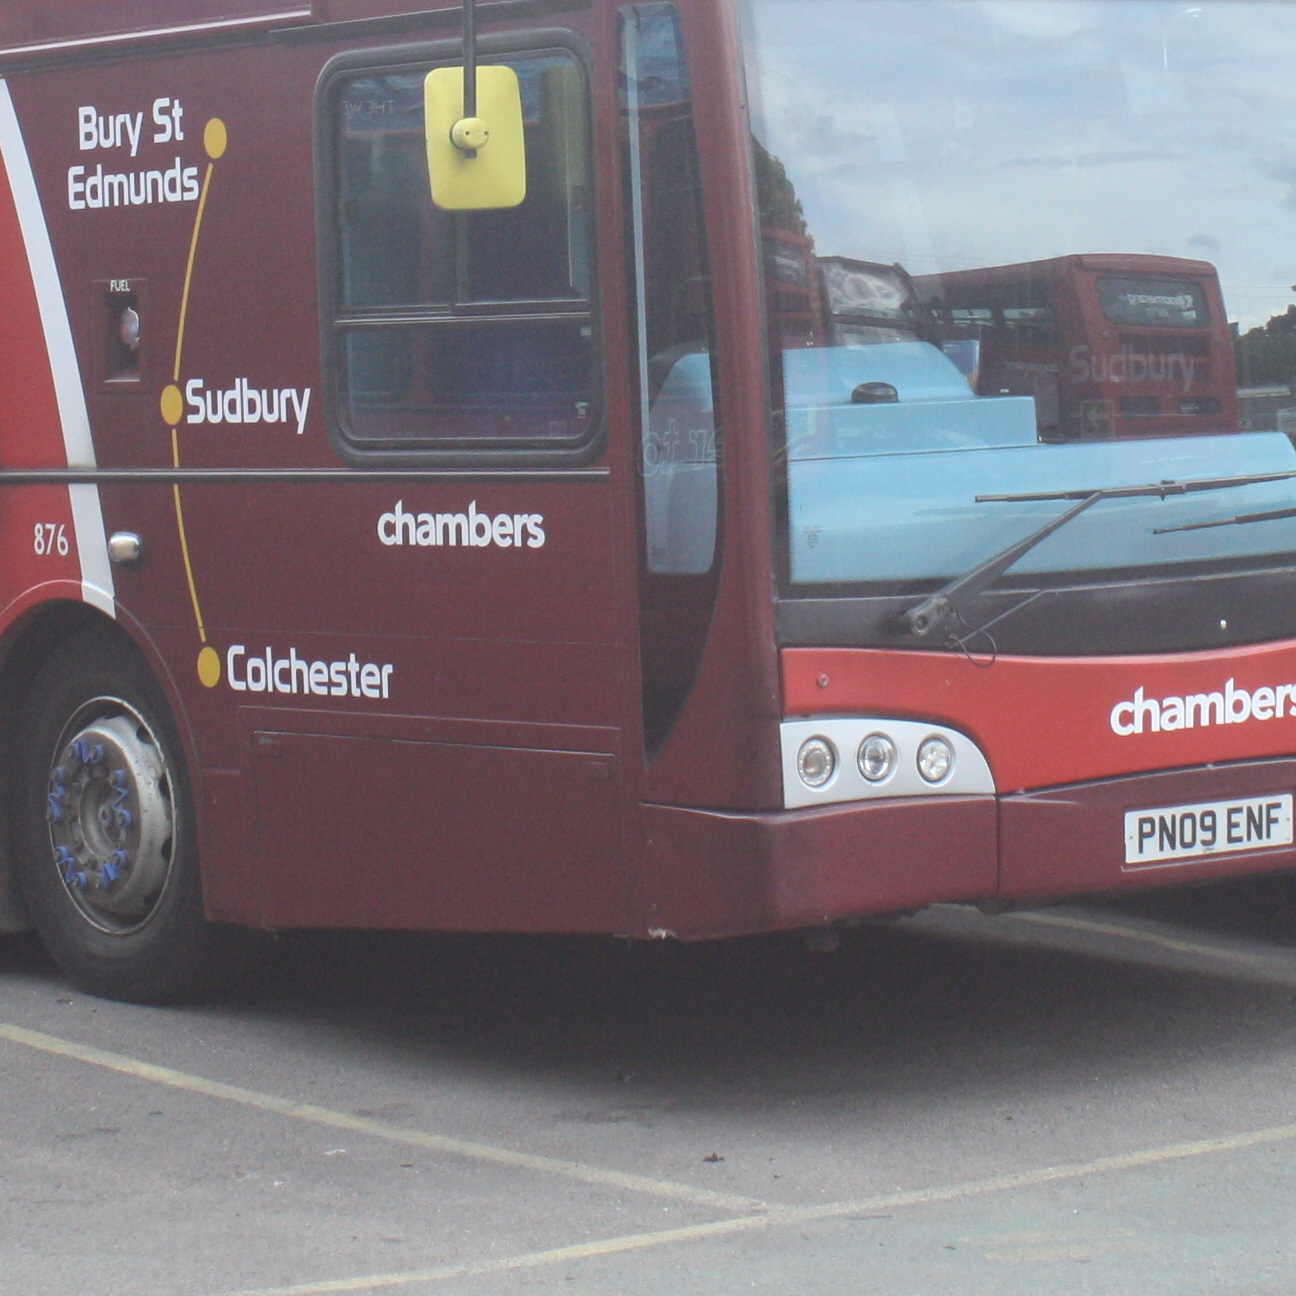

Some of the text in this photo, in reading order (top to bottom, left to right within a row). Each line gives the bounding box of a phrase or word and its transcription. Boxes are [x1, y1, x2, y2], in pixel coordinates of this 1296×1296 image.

[78, 97, 184, 157] Bury St
[67, 156, 199, 210] Edmunds
[109, 279, 131, 293] FUEL
[1070, 344, 1195, 391] Sudbury
[185, 377, 311, 435] Sudbury
[33, 522, 69, 556] 876
[377, 499, 546, 549] chambers
[227, 645, 394, 699] Colchester
[1137, 801, 1283, 855] PN09 ENF
